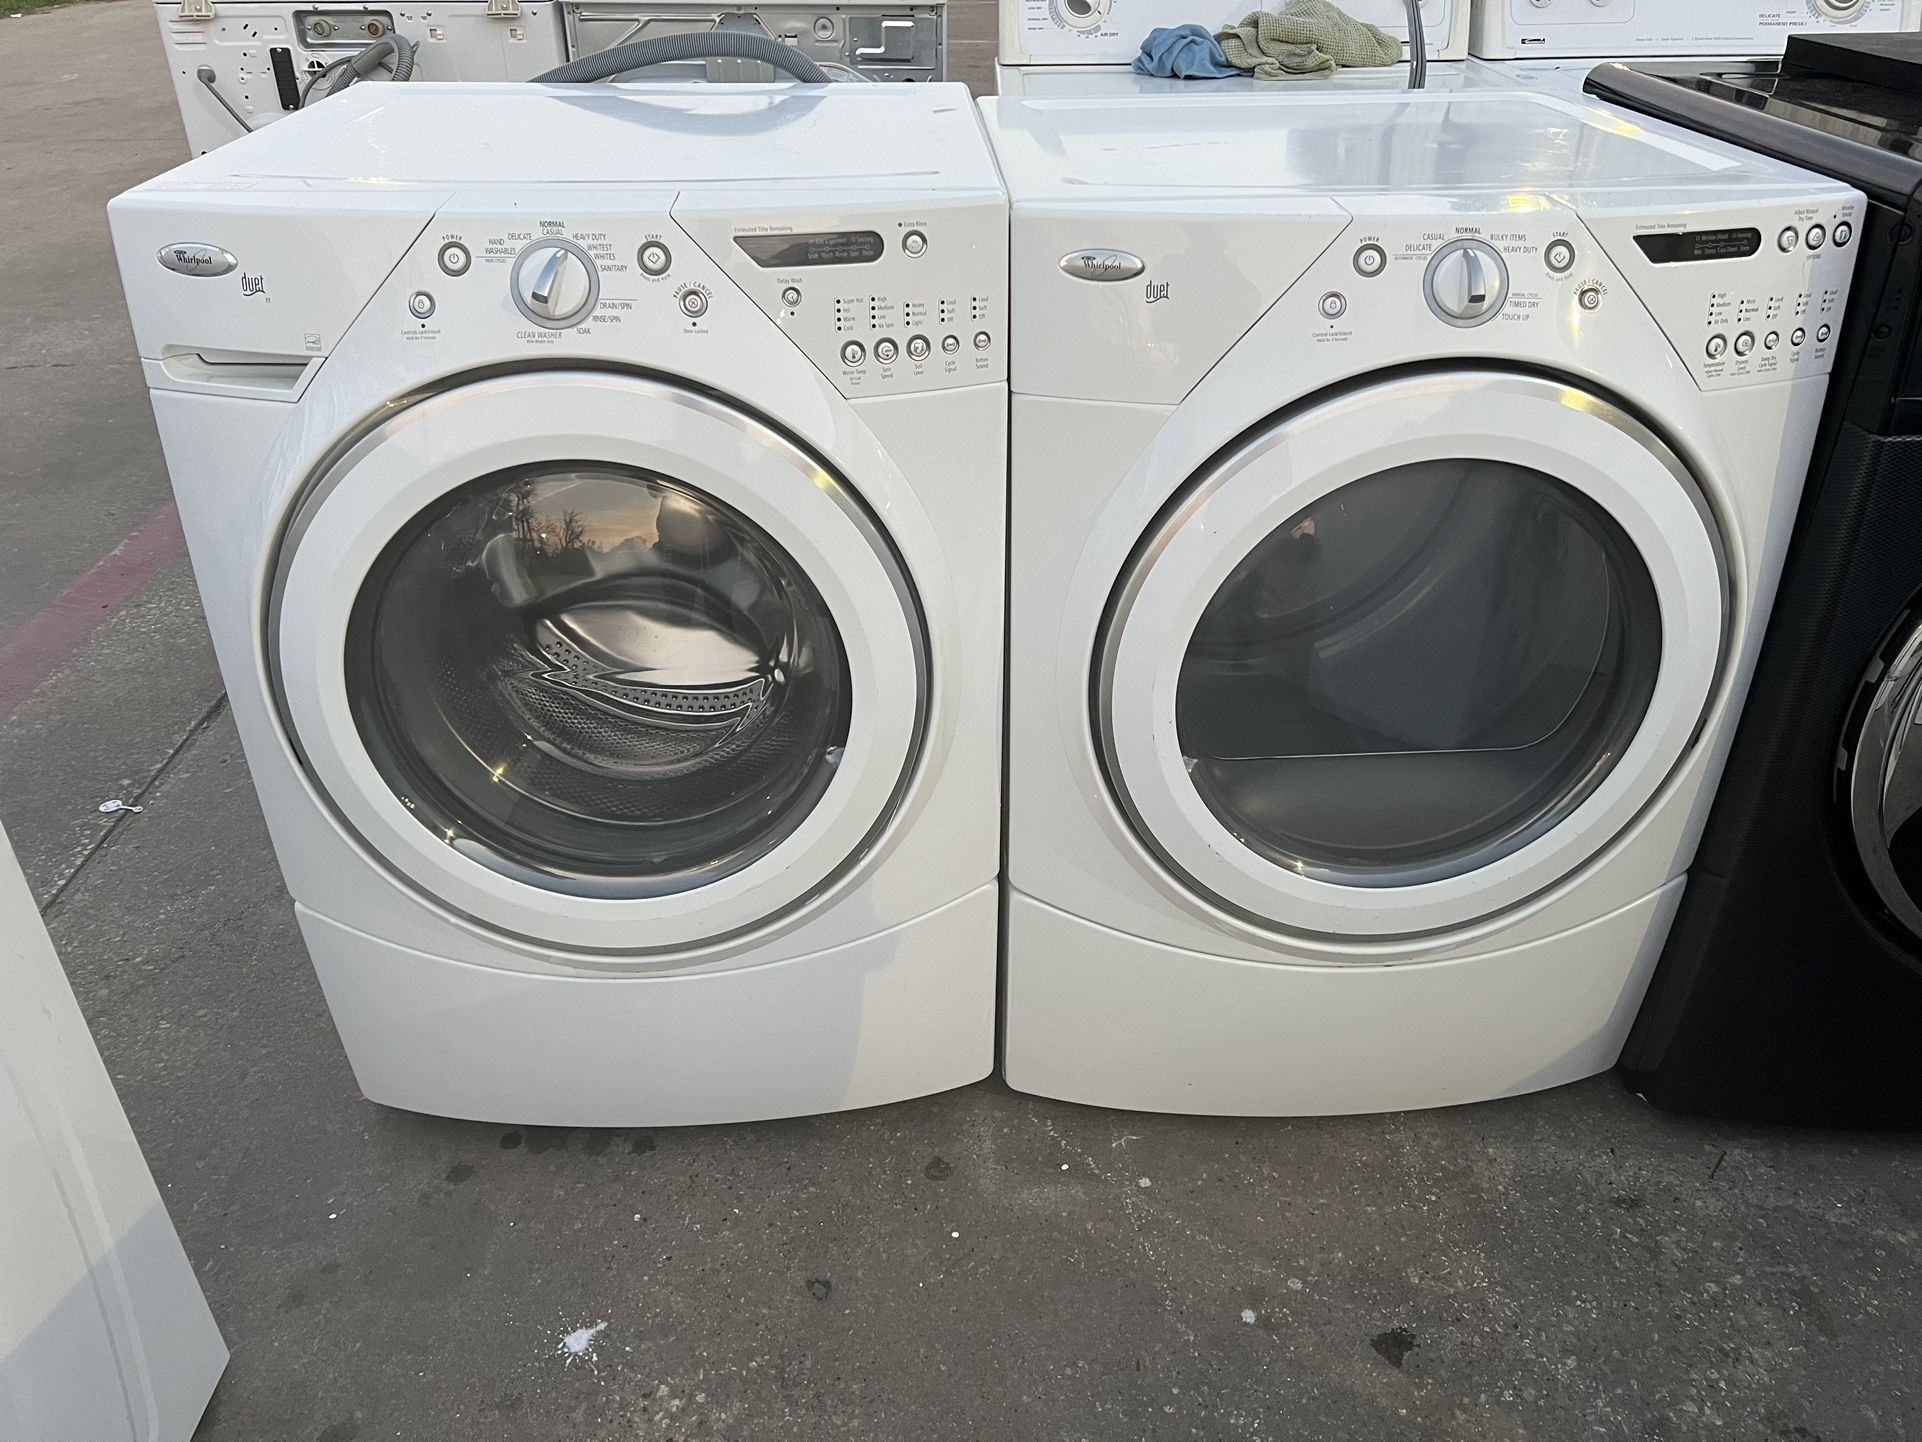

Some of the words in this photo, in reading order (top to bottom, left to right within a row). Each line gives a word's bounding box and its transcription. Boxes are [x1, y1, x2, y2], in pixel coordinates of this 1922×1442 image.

[176, 254, 212, 265] Whirlpool
[1084, 260, 1121, 270] Whirlpool
[241, 272, 265, 296] duet
[1146, 280, 1170, 303] duet
